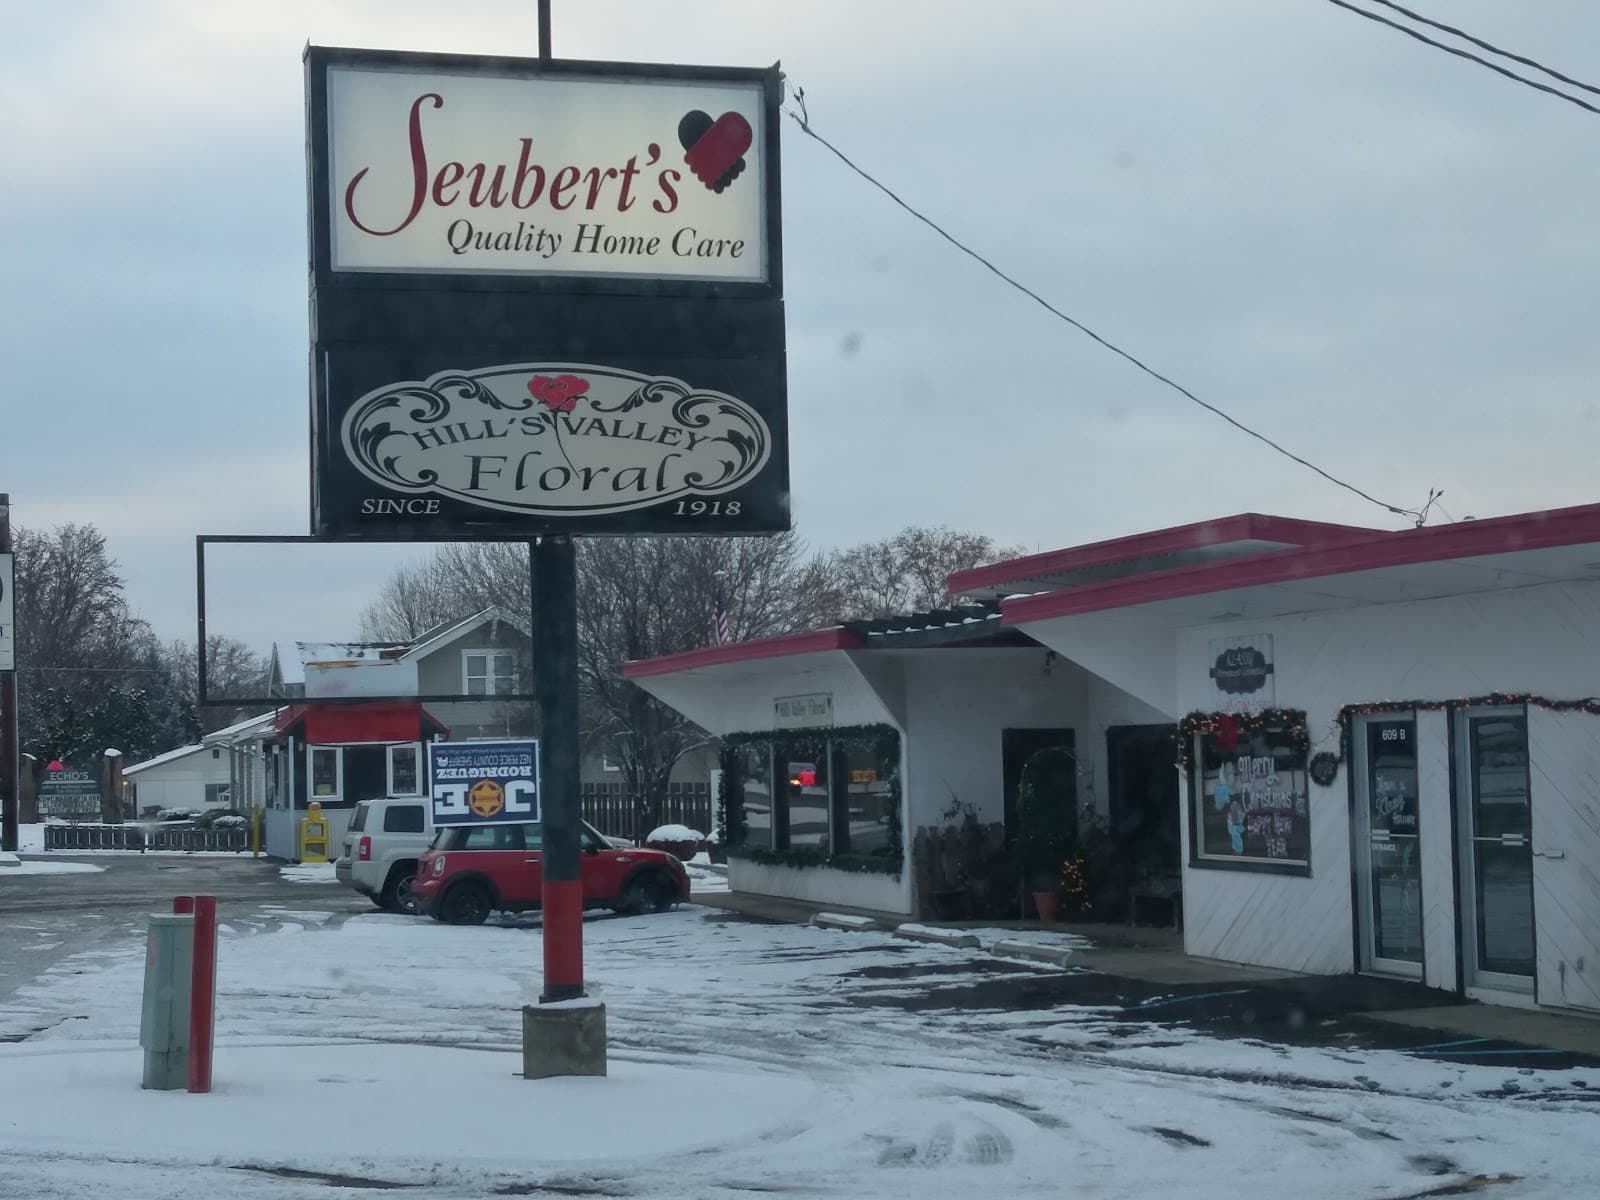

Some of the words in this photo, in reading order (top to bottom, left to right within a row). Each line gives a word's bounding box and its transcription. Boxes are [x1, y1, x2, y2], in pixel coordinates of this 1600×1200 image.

[345, 93, 681, 236] Seubert's
[447, 219, 562, 258] Quality
[572, 224, 660, 256] Home
[671, 226, 745, 258] Care
[409, 416, 545, 450] HILL'S
[560, 414, 712, 452] VALLEY
[464, 450, 682, 492] Floral
[361, 498, 440, 515] SINCE
[673, 500, 742, 516] 1918
[1382, 729, 1397, 741] 609
[448, 755, 472, 767] SHERIFF
[473, 755, 498, 765] COUNTY
[50, 772, 89, 781] ECHO'S
[436, 767, 532, 779] RODRIGUEZ
